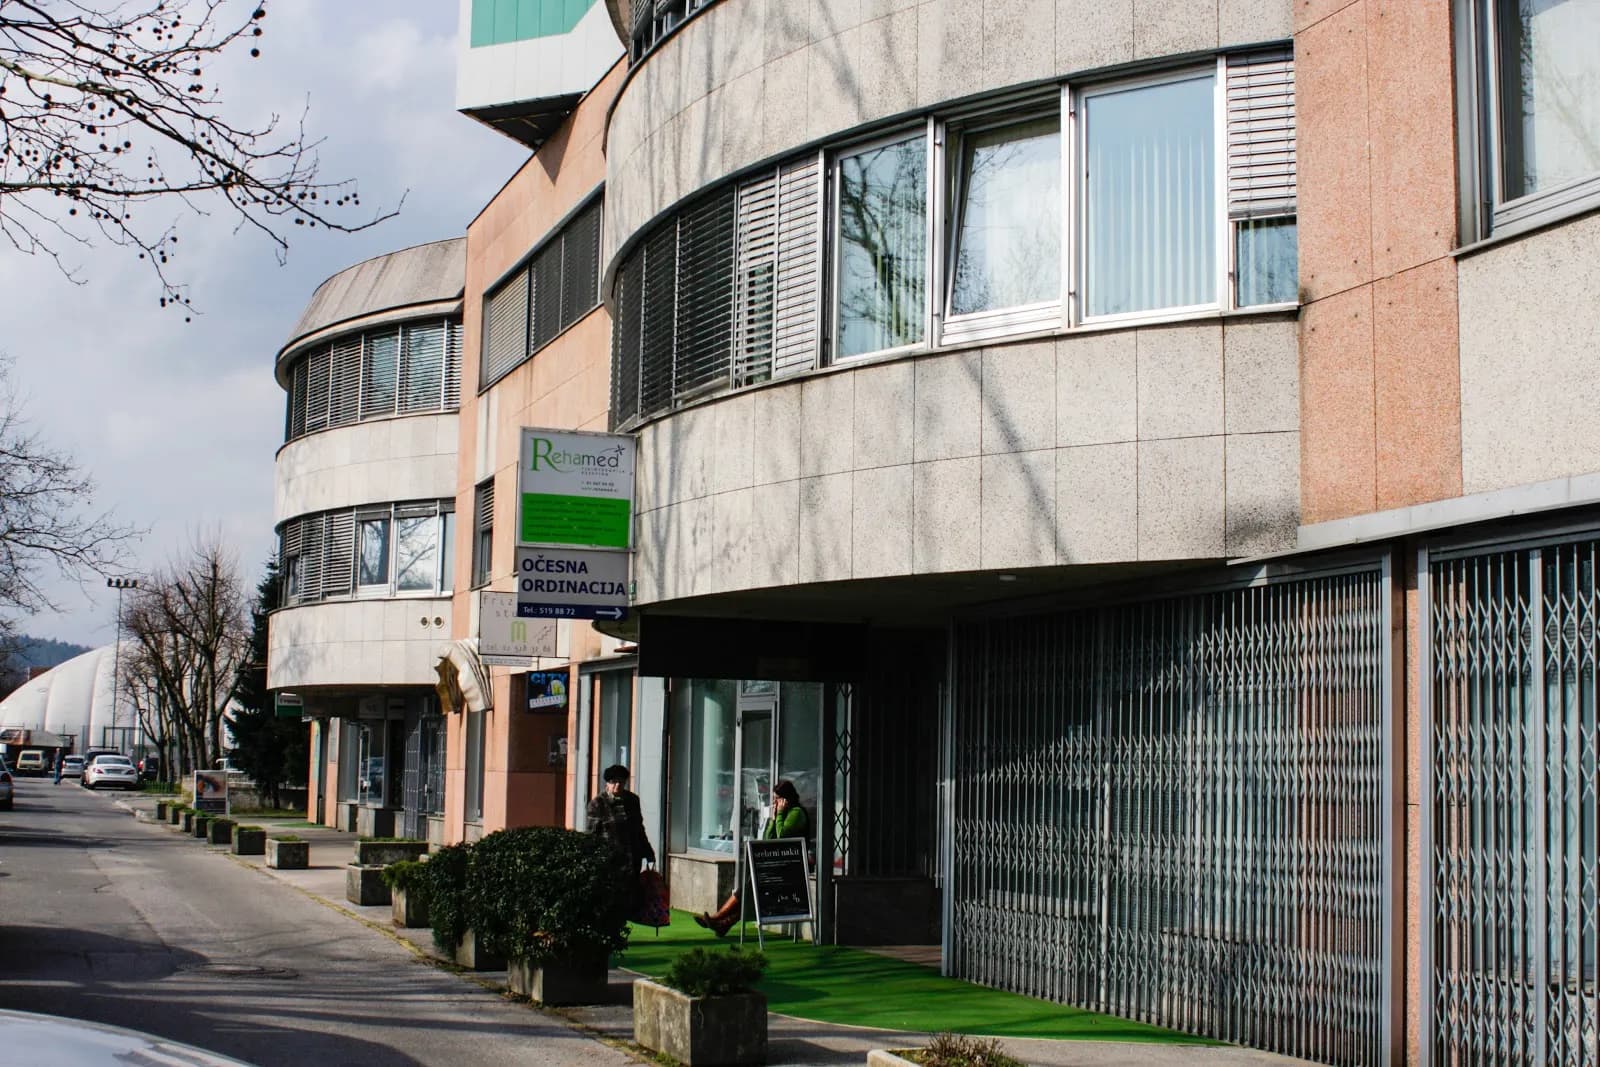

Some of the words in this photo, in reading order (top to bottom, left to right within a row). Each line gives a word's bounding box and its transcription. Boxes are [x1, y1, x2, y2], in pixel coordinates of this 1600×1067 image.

[530, 437, 619, 473] Rehamed
[522, 554, 588, 574] OČESNA
[521, 579, 626, 596] ORDINACIJA
[566, 608, 576, 616] 72
[531, 672, 567, 685] CITY
